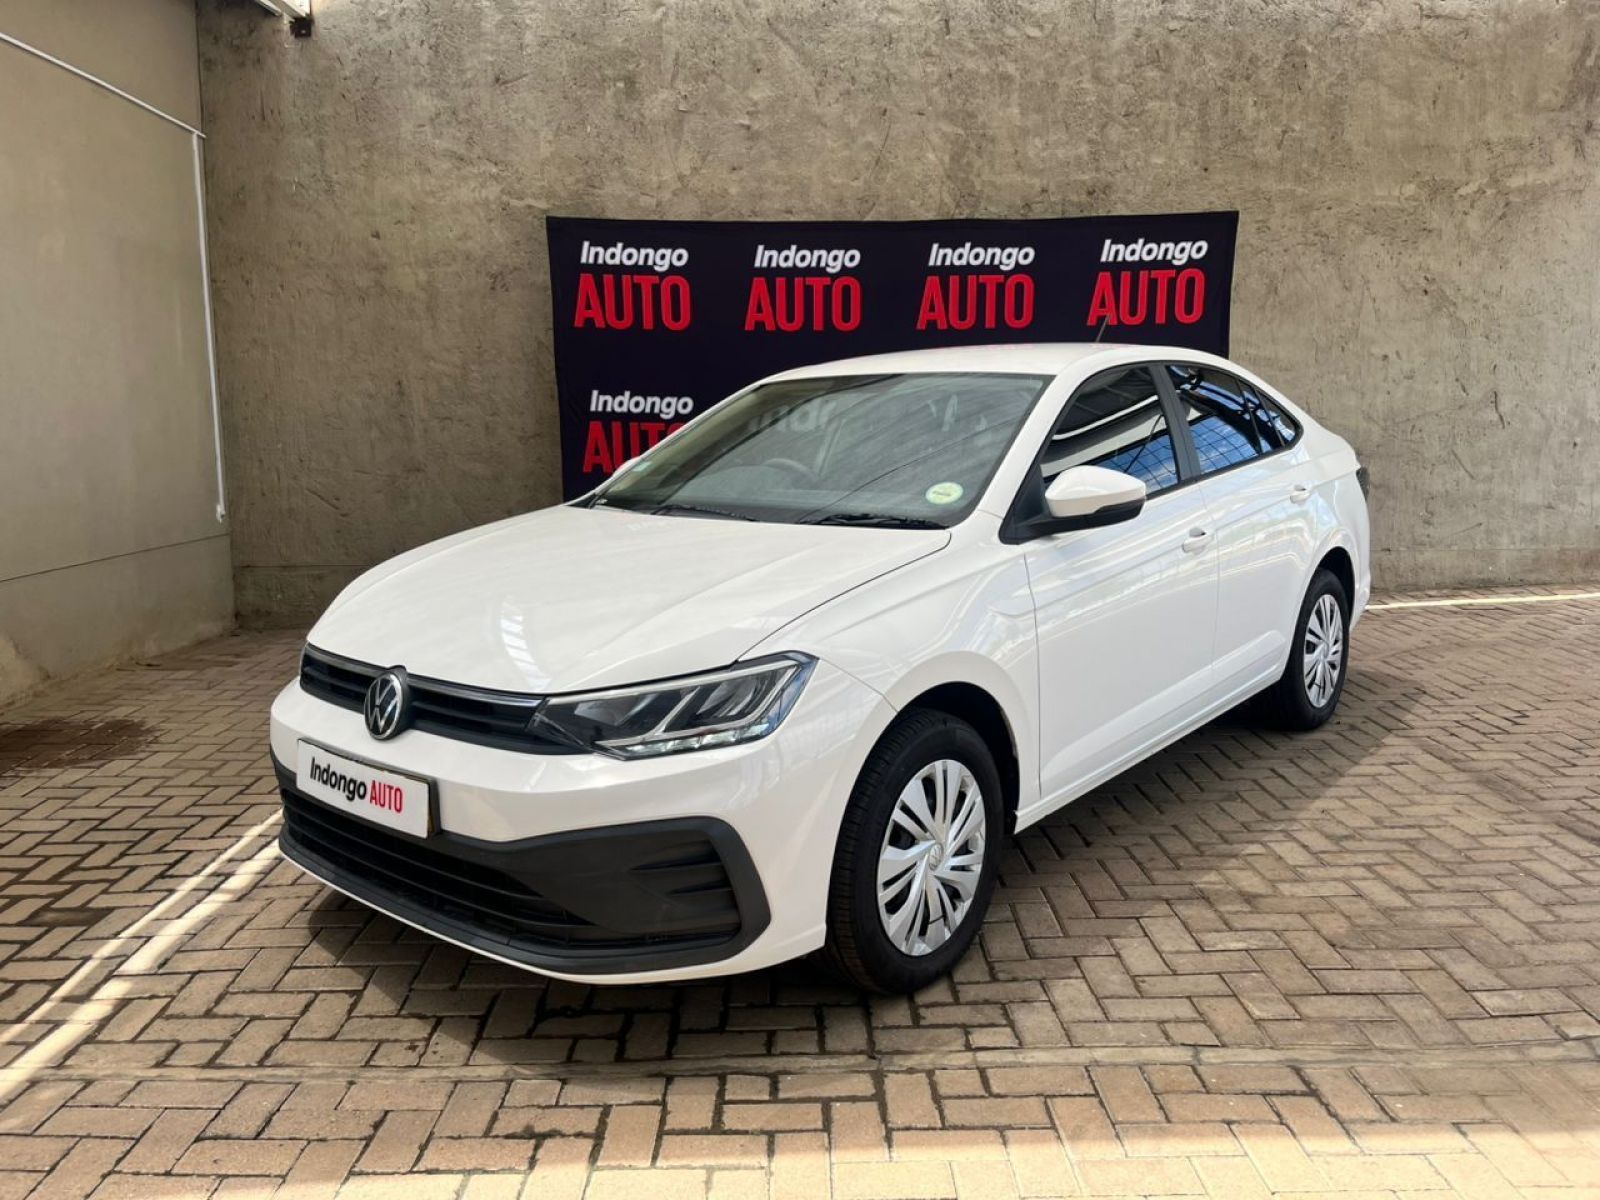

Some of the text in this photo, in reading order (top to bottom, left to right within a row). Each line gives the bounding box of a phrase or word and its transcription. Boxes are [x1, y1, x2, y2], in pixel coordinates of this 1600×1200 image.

[580, 240, 689, 272] Indongo
[754, 244, 861, 274] Indongo
[929, 242, 1035, 271] Indongo
[1100, 239, 1208, 265] Indongo
[574, 273, 692, 331] AUTO
[744, 276, 863, 332] AUTO
[916, 274, 1035, 331] AUTO
[1086, 267, 1206, 327] AUTO
[589, 389, 694, 420] Indongo
[583, 420, 687, 475] AUT
[310, 757, 403, 814] Indongo AUTO
